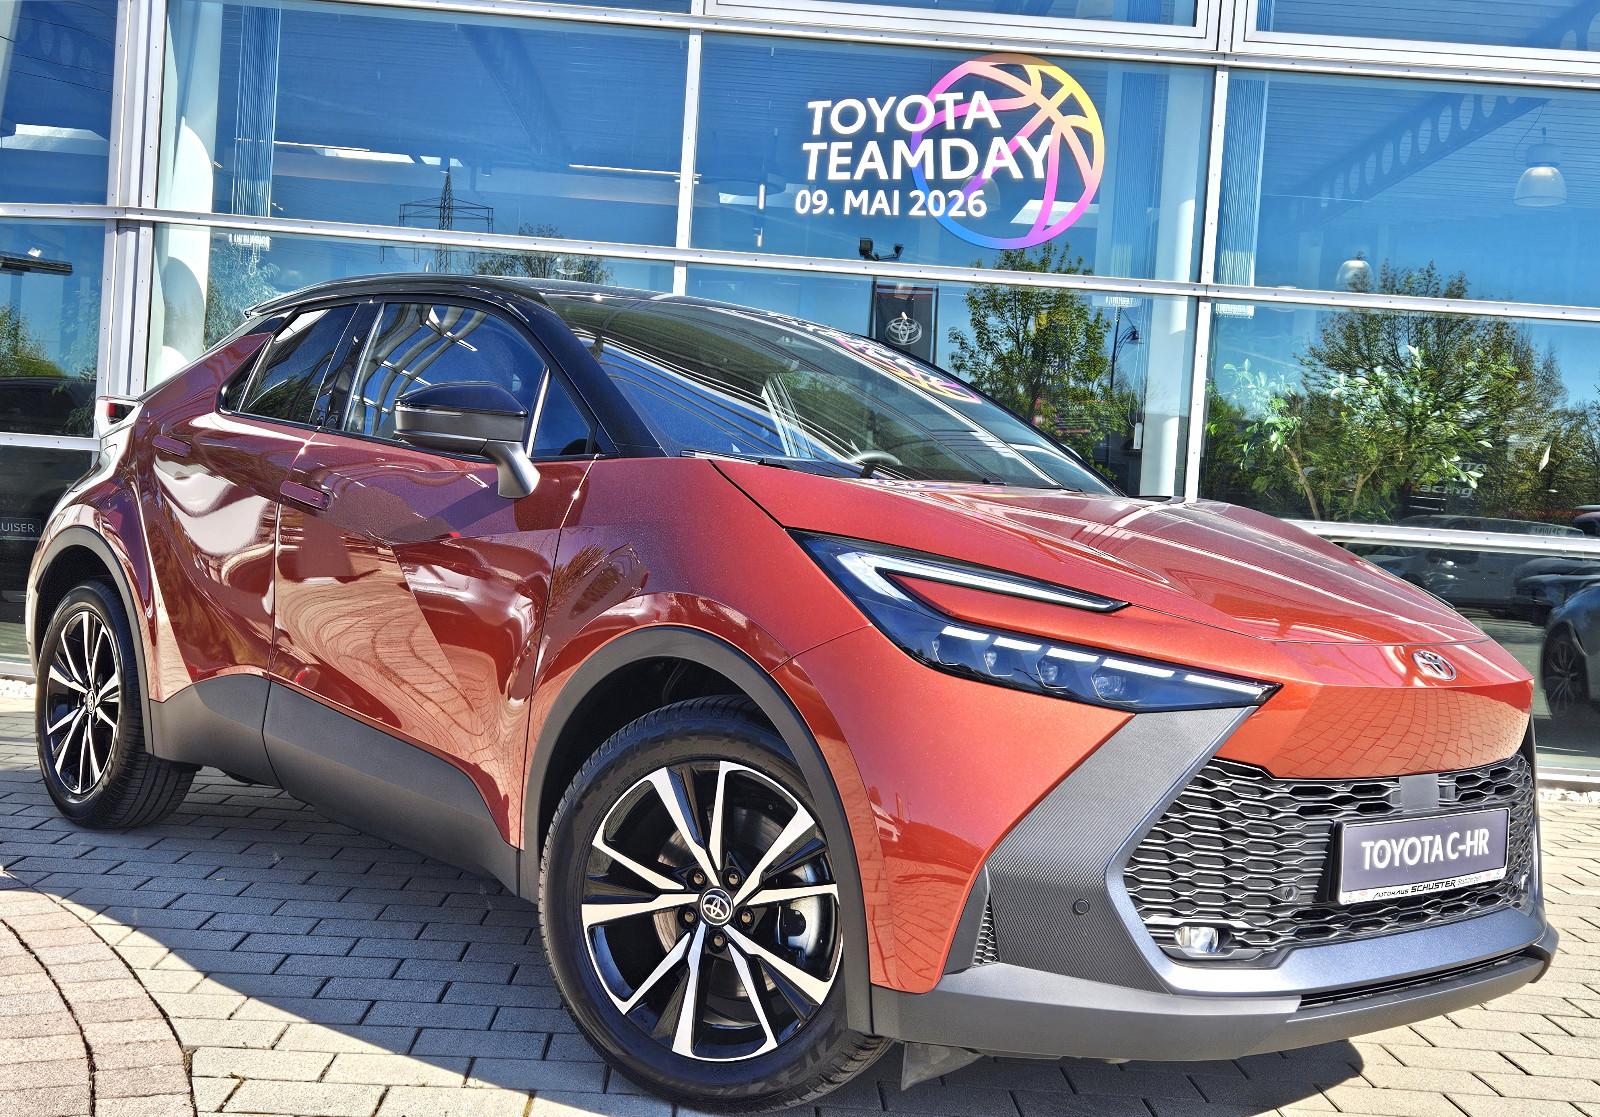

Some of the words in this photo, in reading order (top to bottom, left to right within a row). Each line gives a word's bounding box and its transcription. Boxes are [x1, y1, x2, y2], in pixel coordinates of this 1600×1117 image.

[807, 90, 1001, 135] TOYOTA
[802, 135, 1053, 181] TEAMDAY
[794, 189, 835, 215] 09.
[843, 189, 899, 216] MAI
[908, 189, 987, 217] 2026
[0, 522, 35, 533] UISER
[1361, 834, 1444, 870] TOYOTA
[1446, 828, 1490, 860] C-HR
[1410, 879, 1457, 893] SCHUSTER
